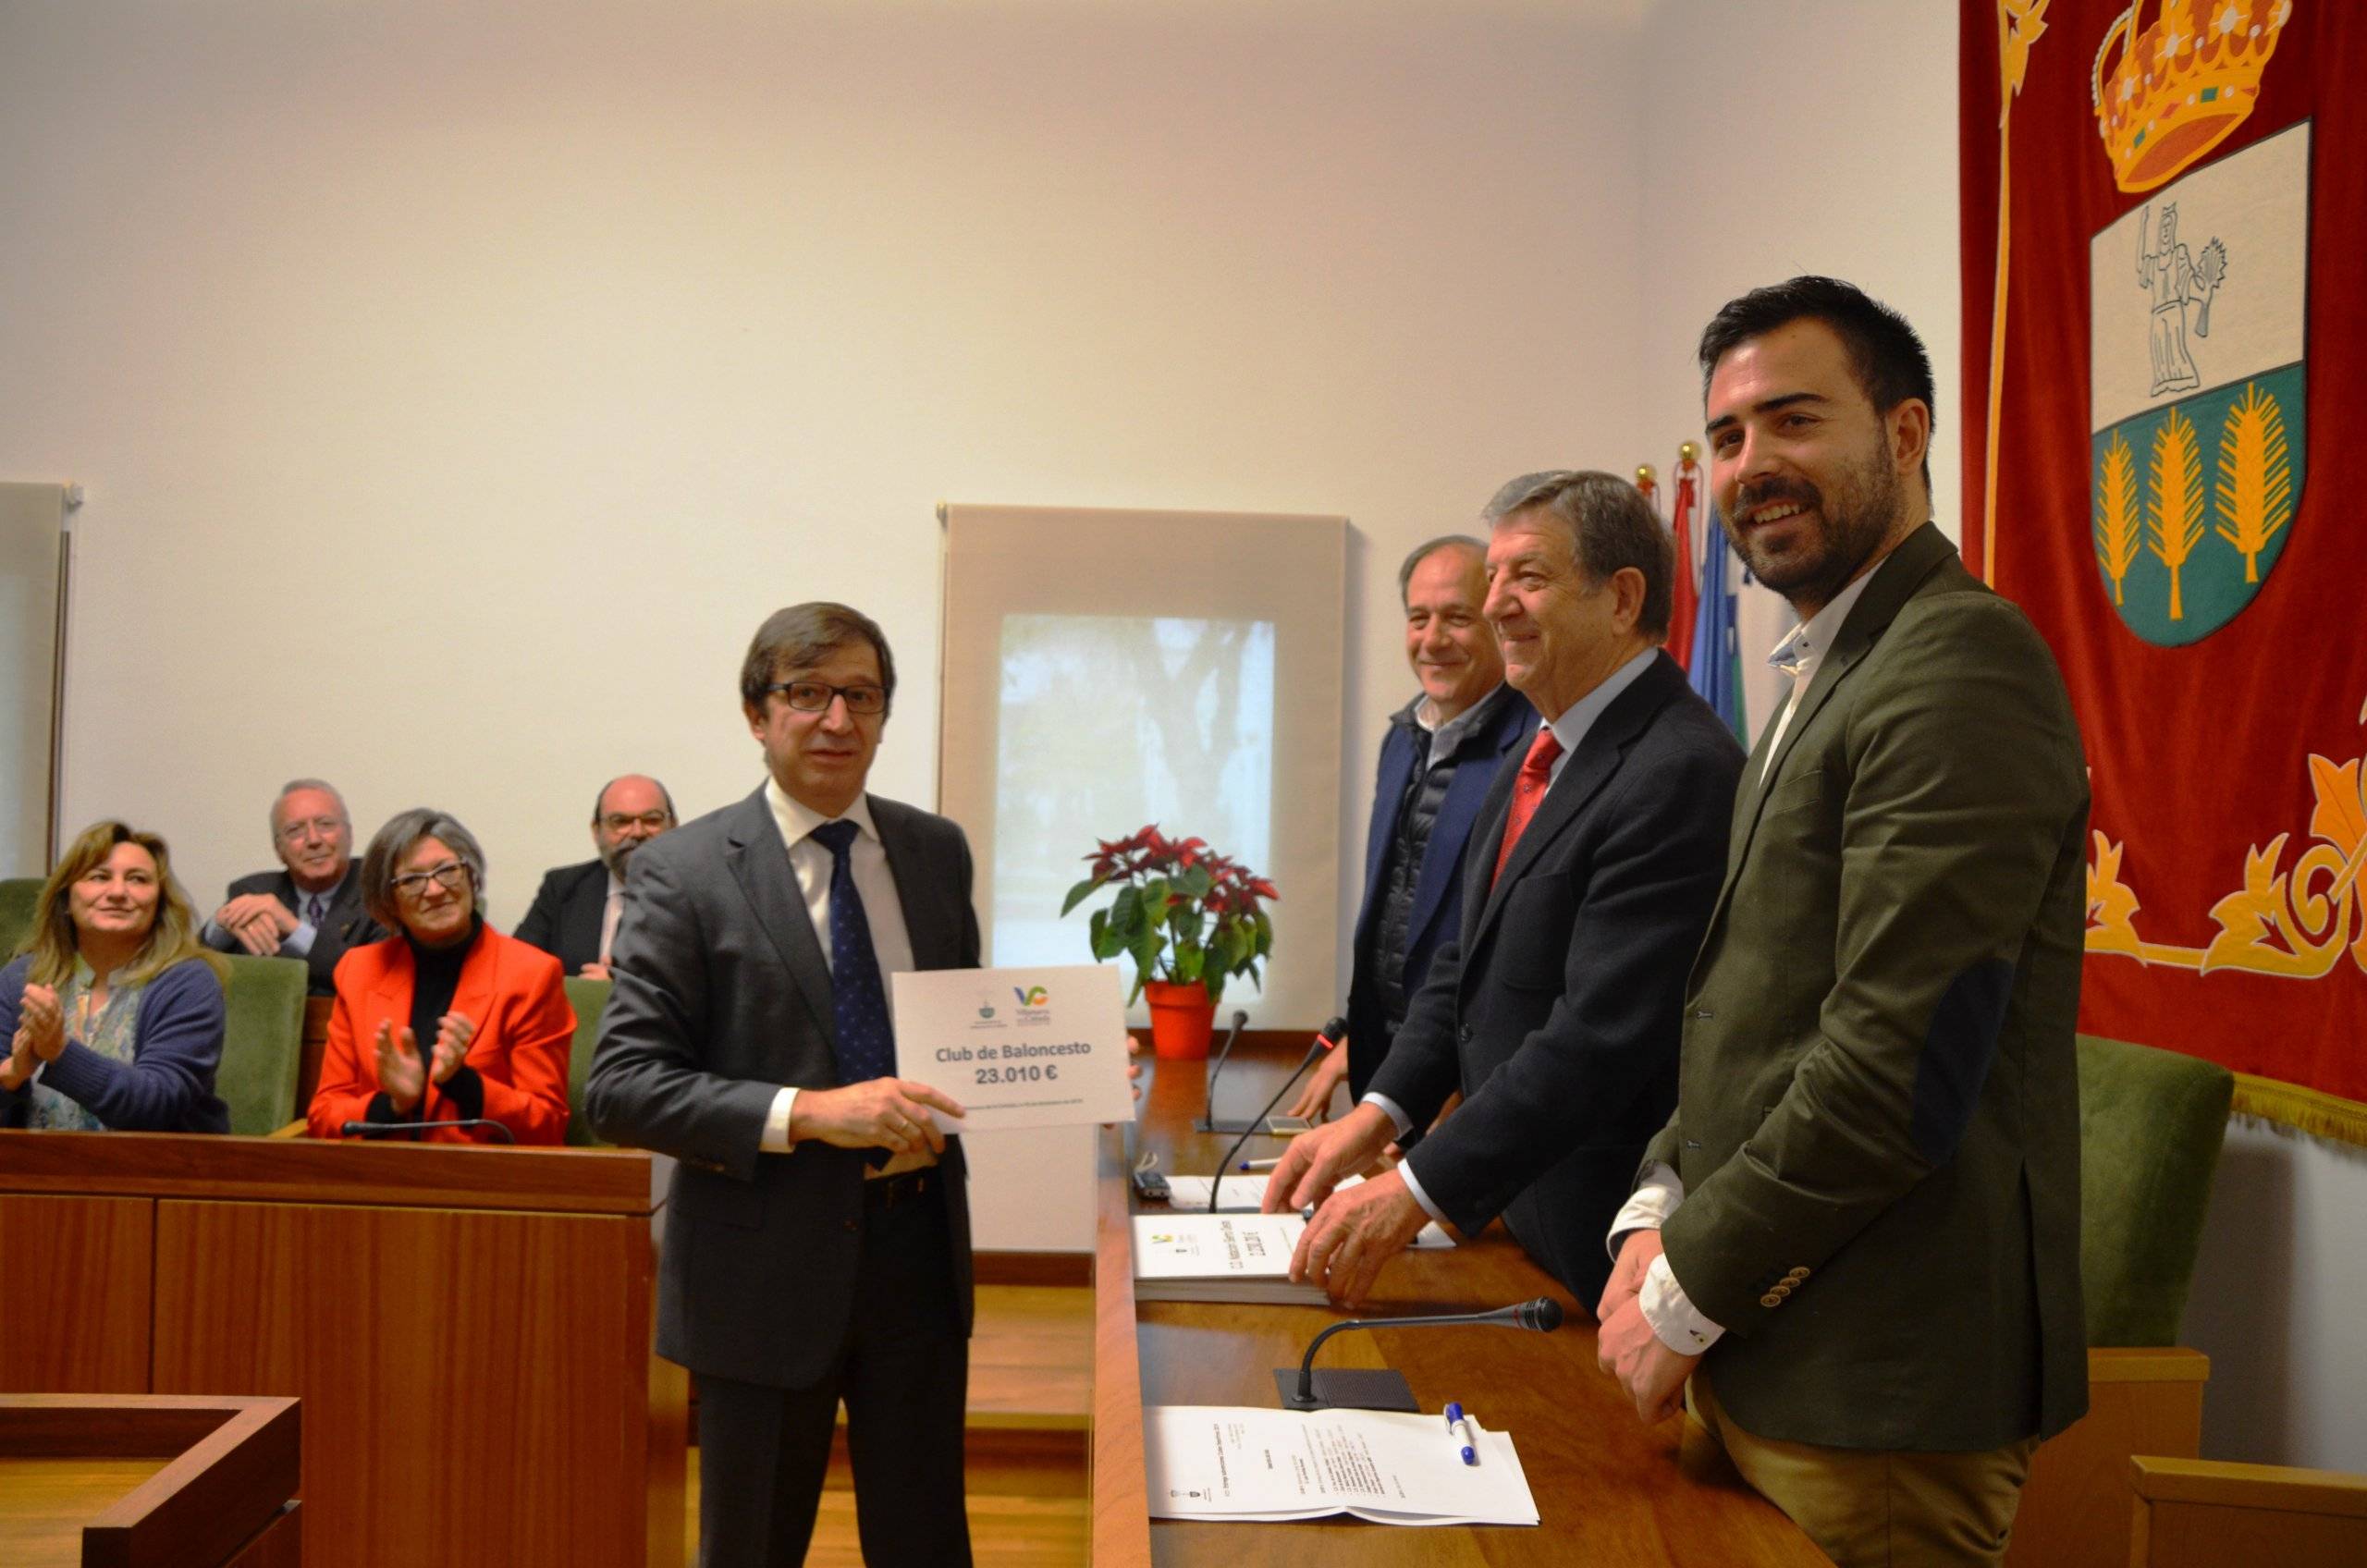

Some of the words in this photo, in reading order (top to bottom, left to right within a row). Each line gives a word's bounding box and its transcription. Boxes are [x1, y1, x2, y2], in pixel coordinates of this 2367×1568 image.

[936, 1047, 973, 1062] Club
[977, 1046, 999, 1060] de
[1002, 1042, 1091, 1059] Baloncesto
[975, 1066, 1041, 1084] 23.010
[1045, 1064, 1058, 1080] €
